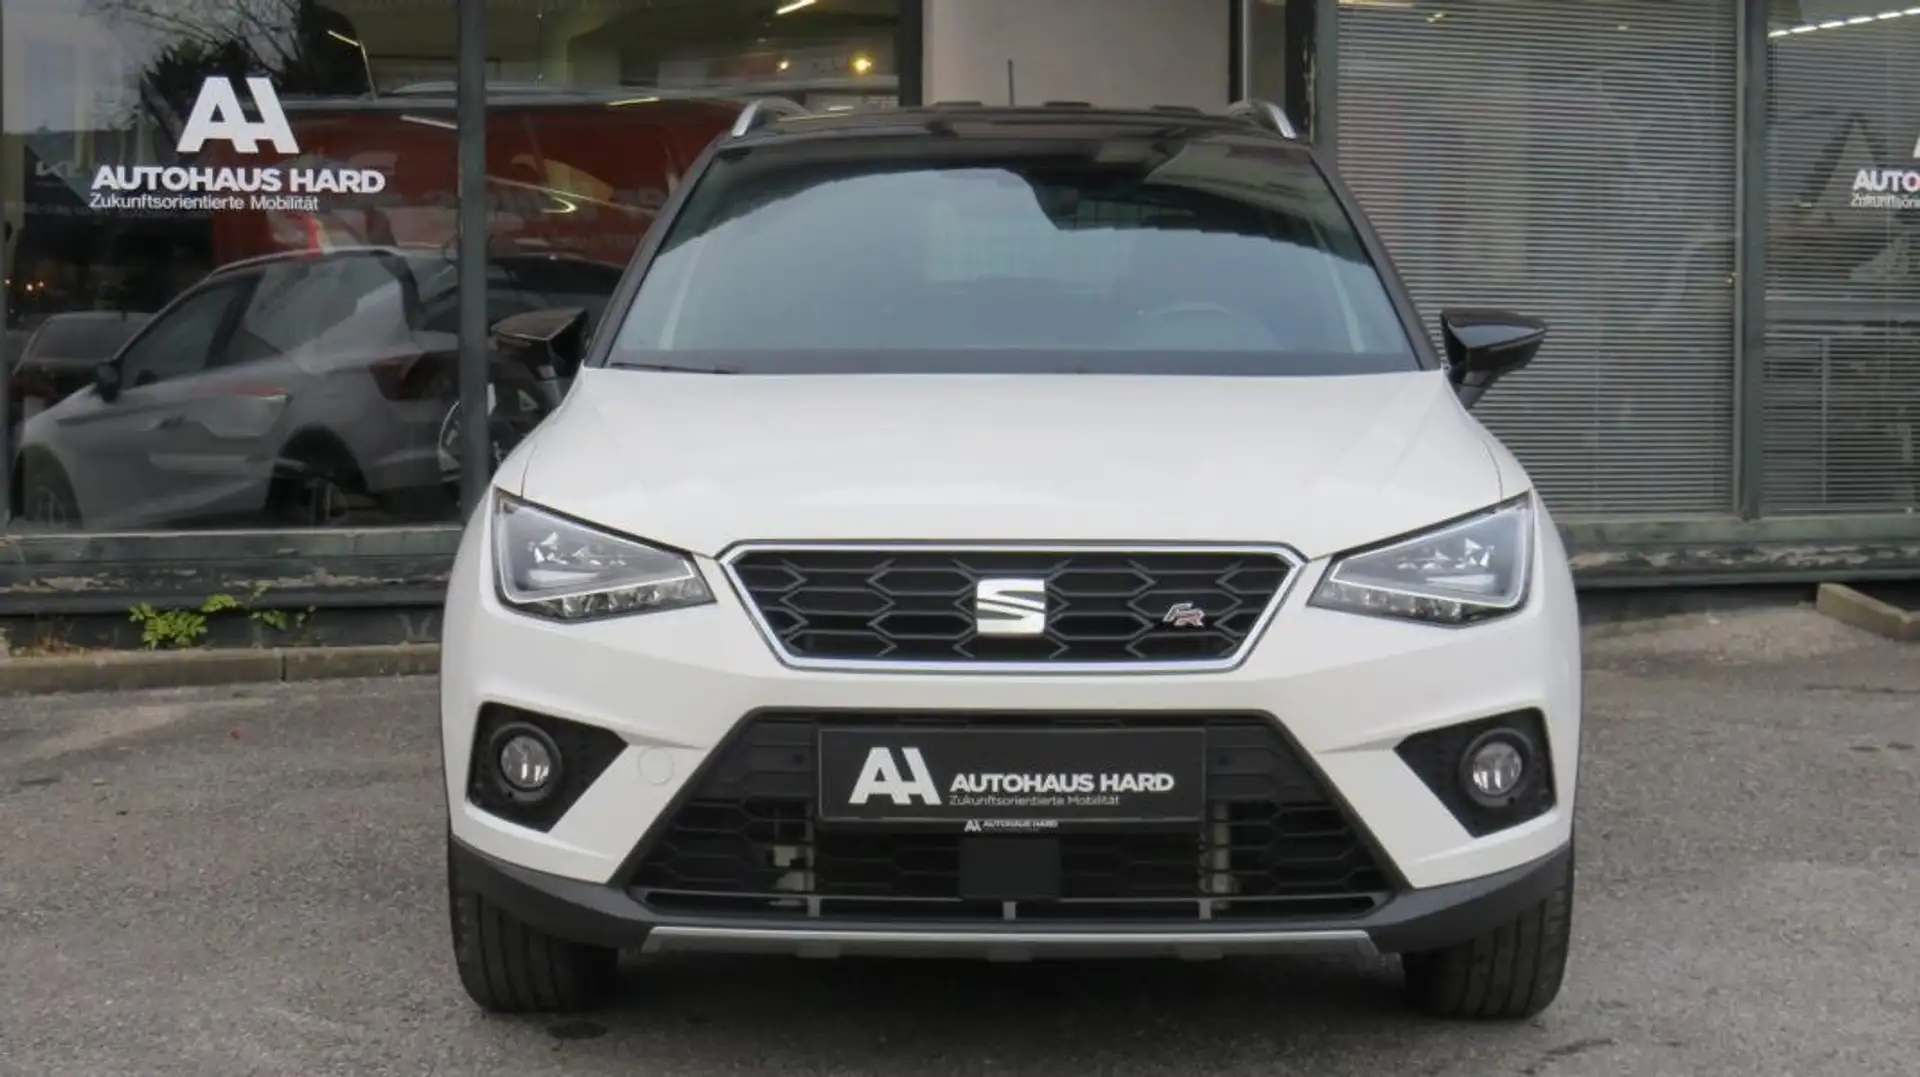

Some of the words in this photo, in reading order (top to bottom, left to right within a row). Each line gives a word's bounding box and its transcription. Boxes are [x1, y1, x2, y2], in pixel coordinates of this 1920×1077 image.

[92, 164, 281, 192] AUTOHAUS
[289, 167, 386, 194] HARD
[89, 193, 245, 210] Zukunftsorientierte
[250, 194, 319, 211] Mobilität
[949, 773, 1094, 793] AUTOHAUS
[1099, 773, 1175, 792] HARD
